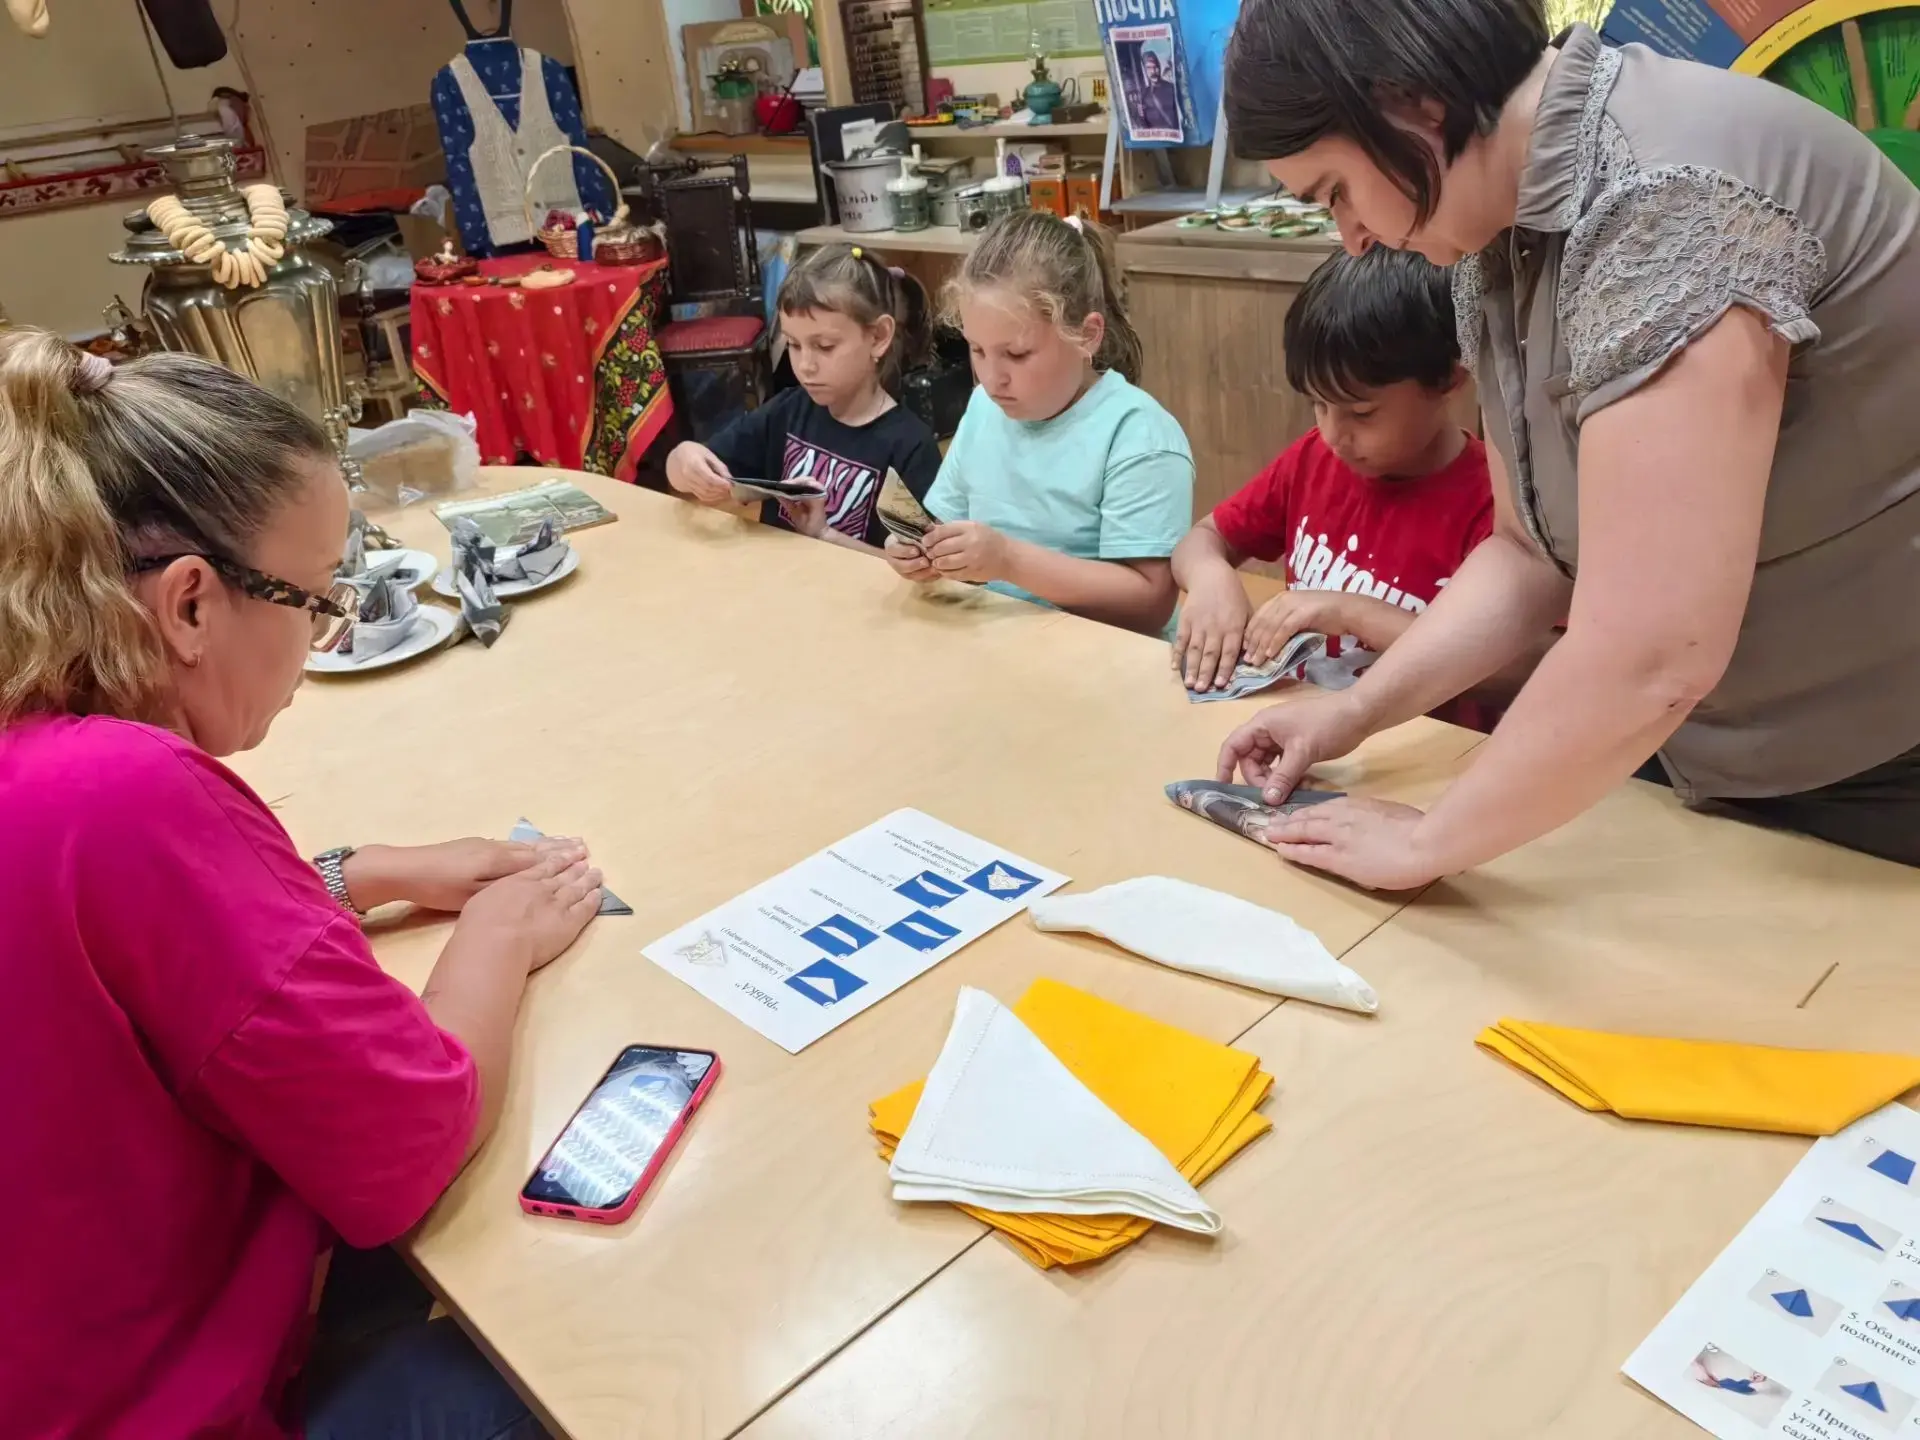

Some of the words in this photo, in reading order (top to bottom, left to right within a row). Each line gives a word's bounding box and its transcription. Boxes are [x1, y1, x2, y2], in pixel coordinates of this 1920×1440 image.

[1896, 1250, 1920, 1265] угл
[1848, 1312, 1860, 1322] 5.
[1865, 1320, 1893, 1340] Оба
[1840, 1323, 1917, 1366] подогните
[1801, 1399, 1812, 1411] 7.
